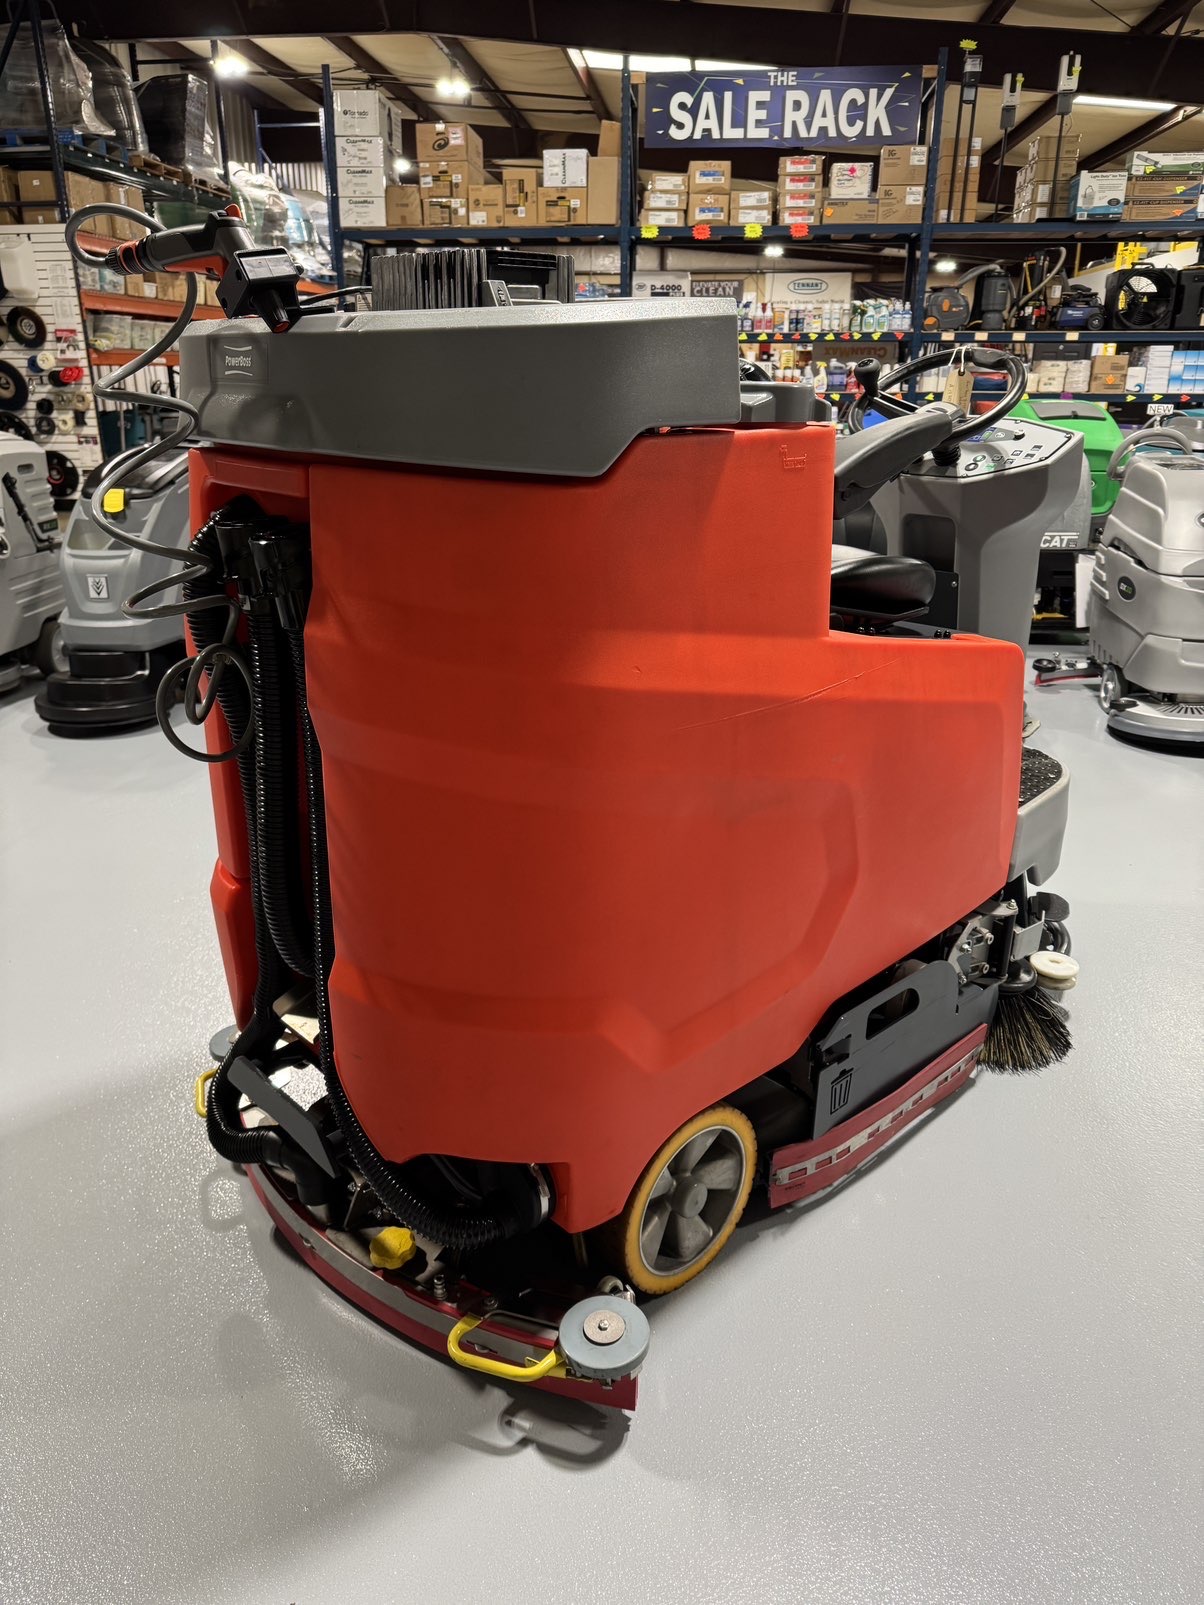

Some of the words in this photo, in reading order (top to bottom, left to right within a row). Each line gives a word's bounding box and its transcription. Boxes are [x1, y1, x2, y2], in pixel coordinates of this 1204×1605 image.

[768, 71, 798, 86] THE
[668, 91, 771, 141] SALE
[782, 87, 896, 138] RACK
[693, 287, 734, 296] CLEAN
[1149, 405, 1173, 413] NEW
